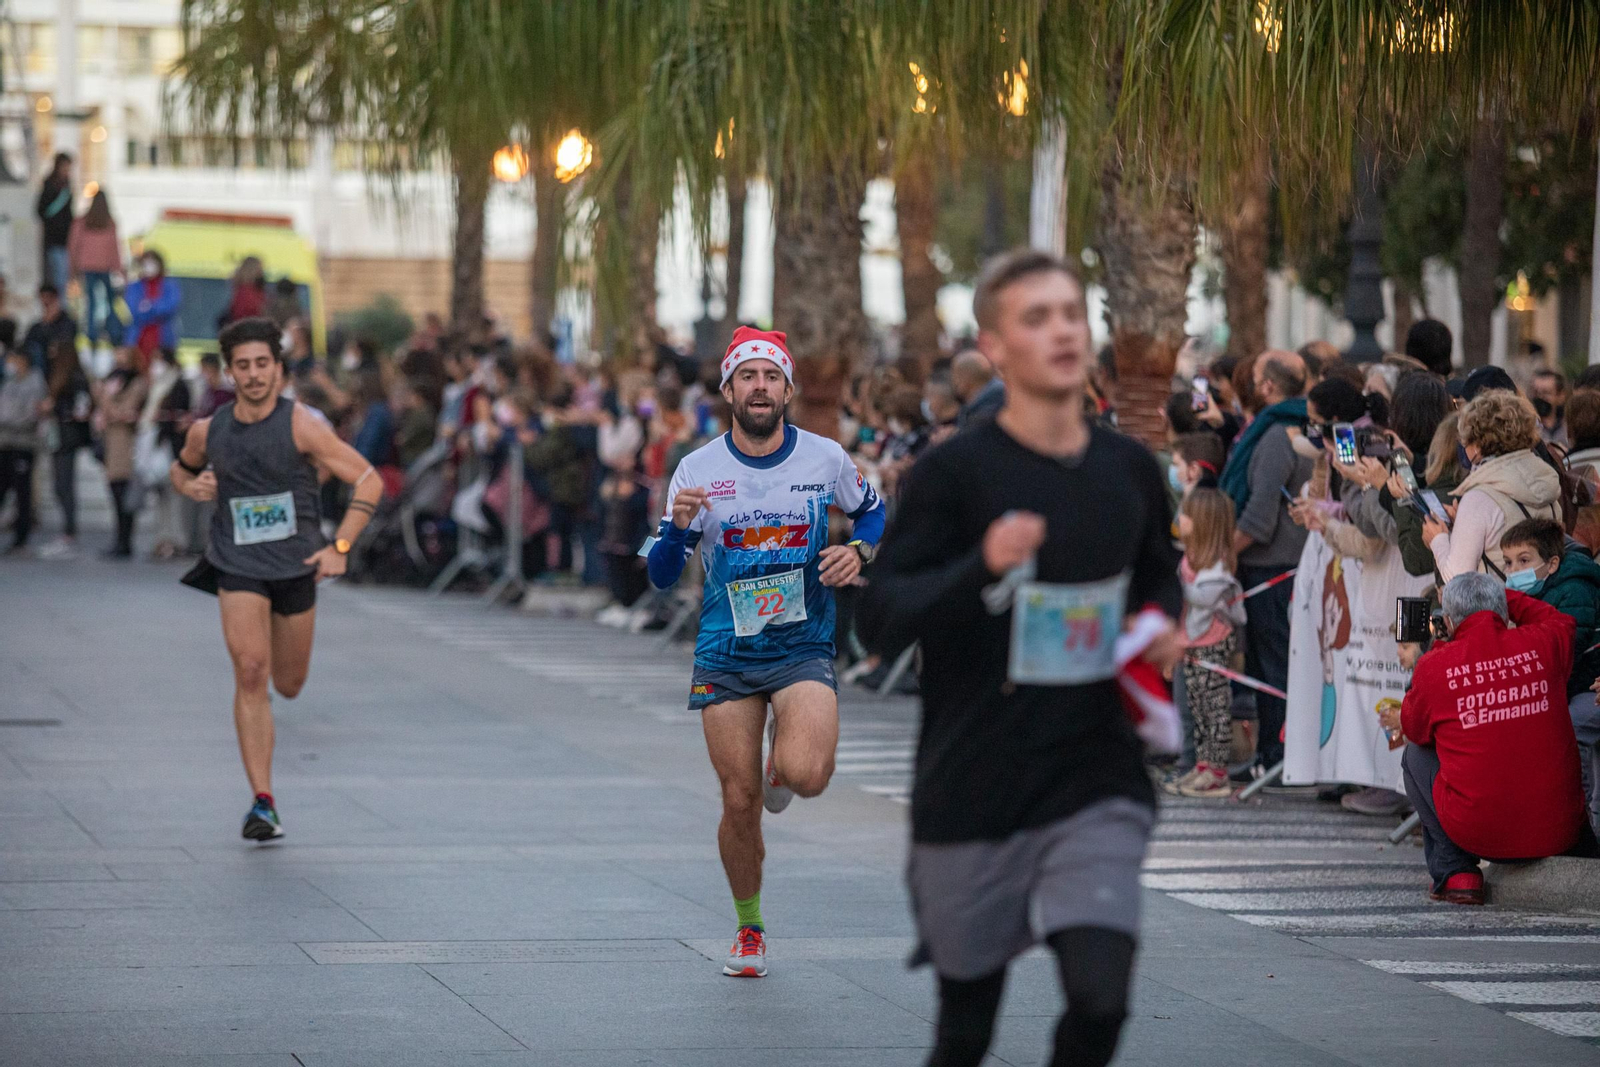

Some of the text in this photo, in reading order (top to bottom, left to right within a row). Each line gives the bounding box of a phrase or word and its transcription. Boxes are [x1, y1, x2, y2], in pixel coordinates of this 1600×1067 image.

[706, 488, 737, 498] amama
[790, 483, 826, 493] FURIOX
[729, 509, 807, 525] Club Deportivo
[740, 582, 756, 592] SAN
[757, 573, 799, 590] SILVESTRE
[754, 593, 786, 617] 22
[1446, 664, 1470, 679] SAN
[1448, 661, 1545, 690] GADITANA
[1457, 680, 1549, 712] FOTÓGRAFO
[1478, 695, 1549, 725] Ermanué
